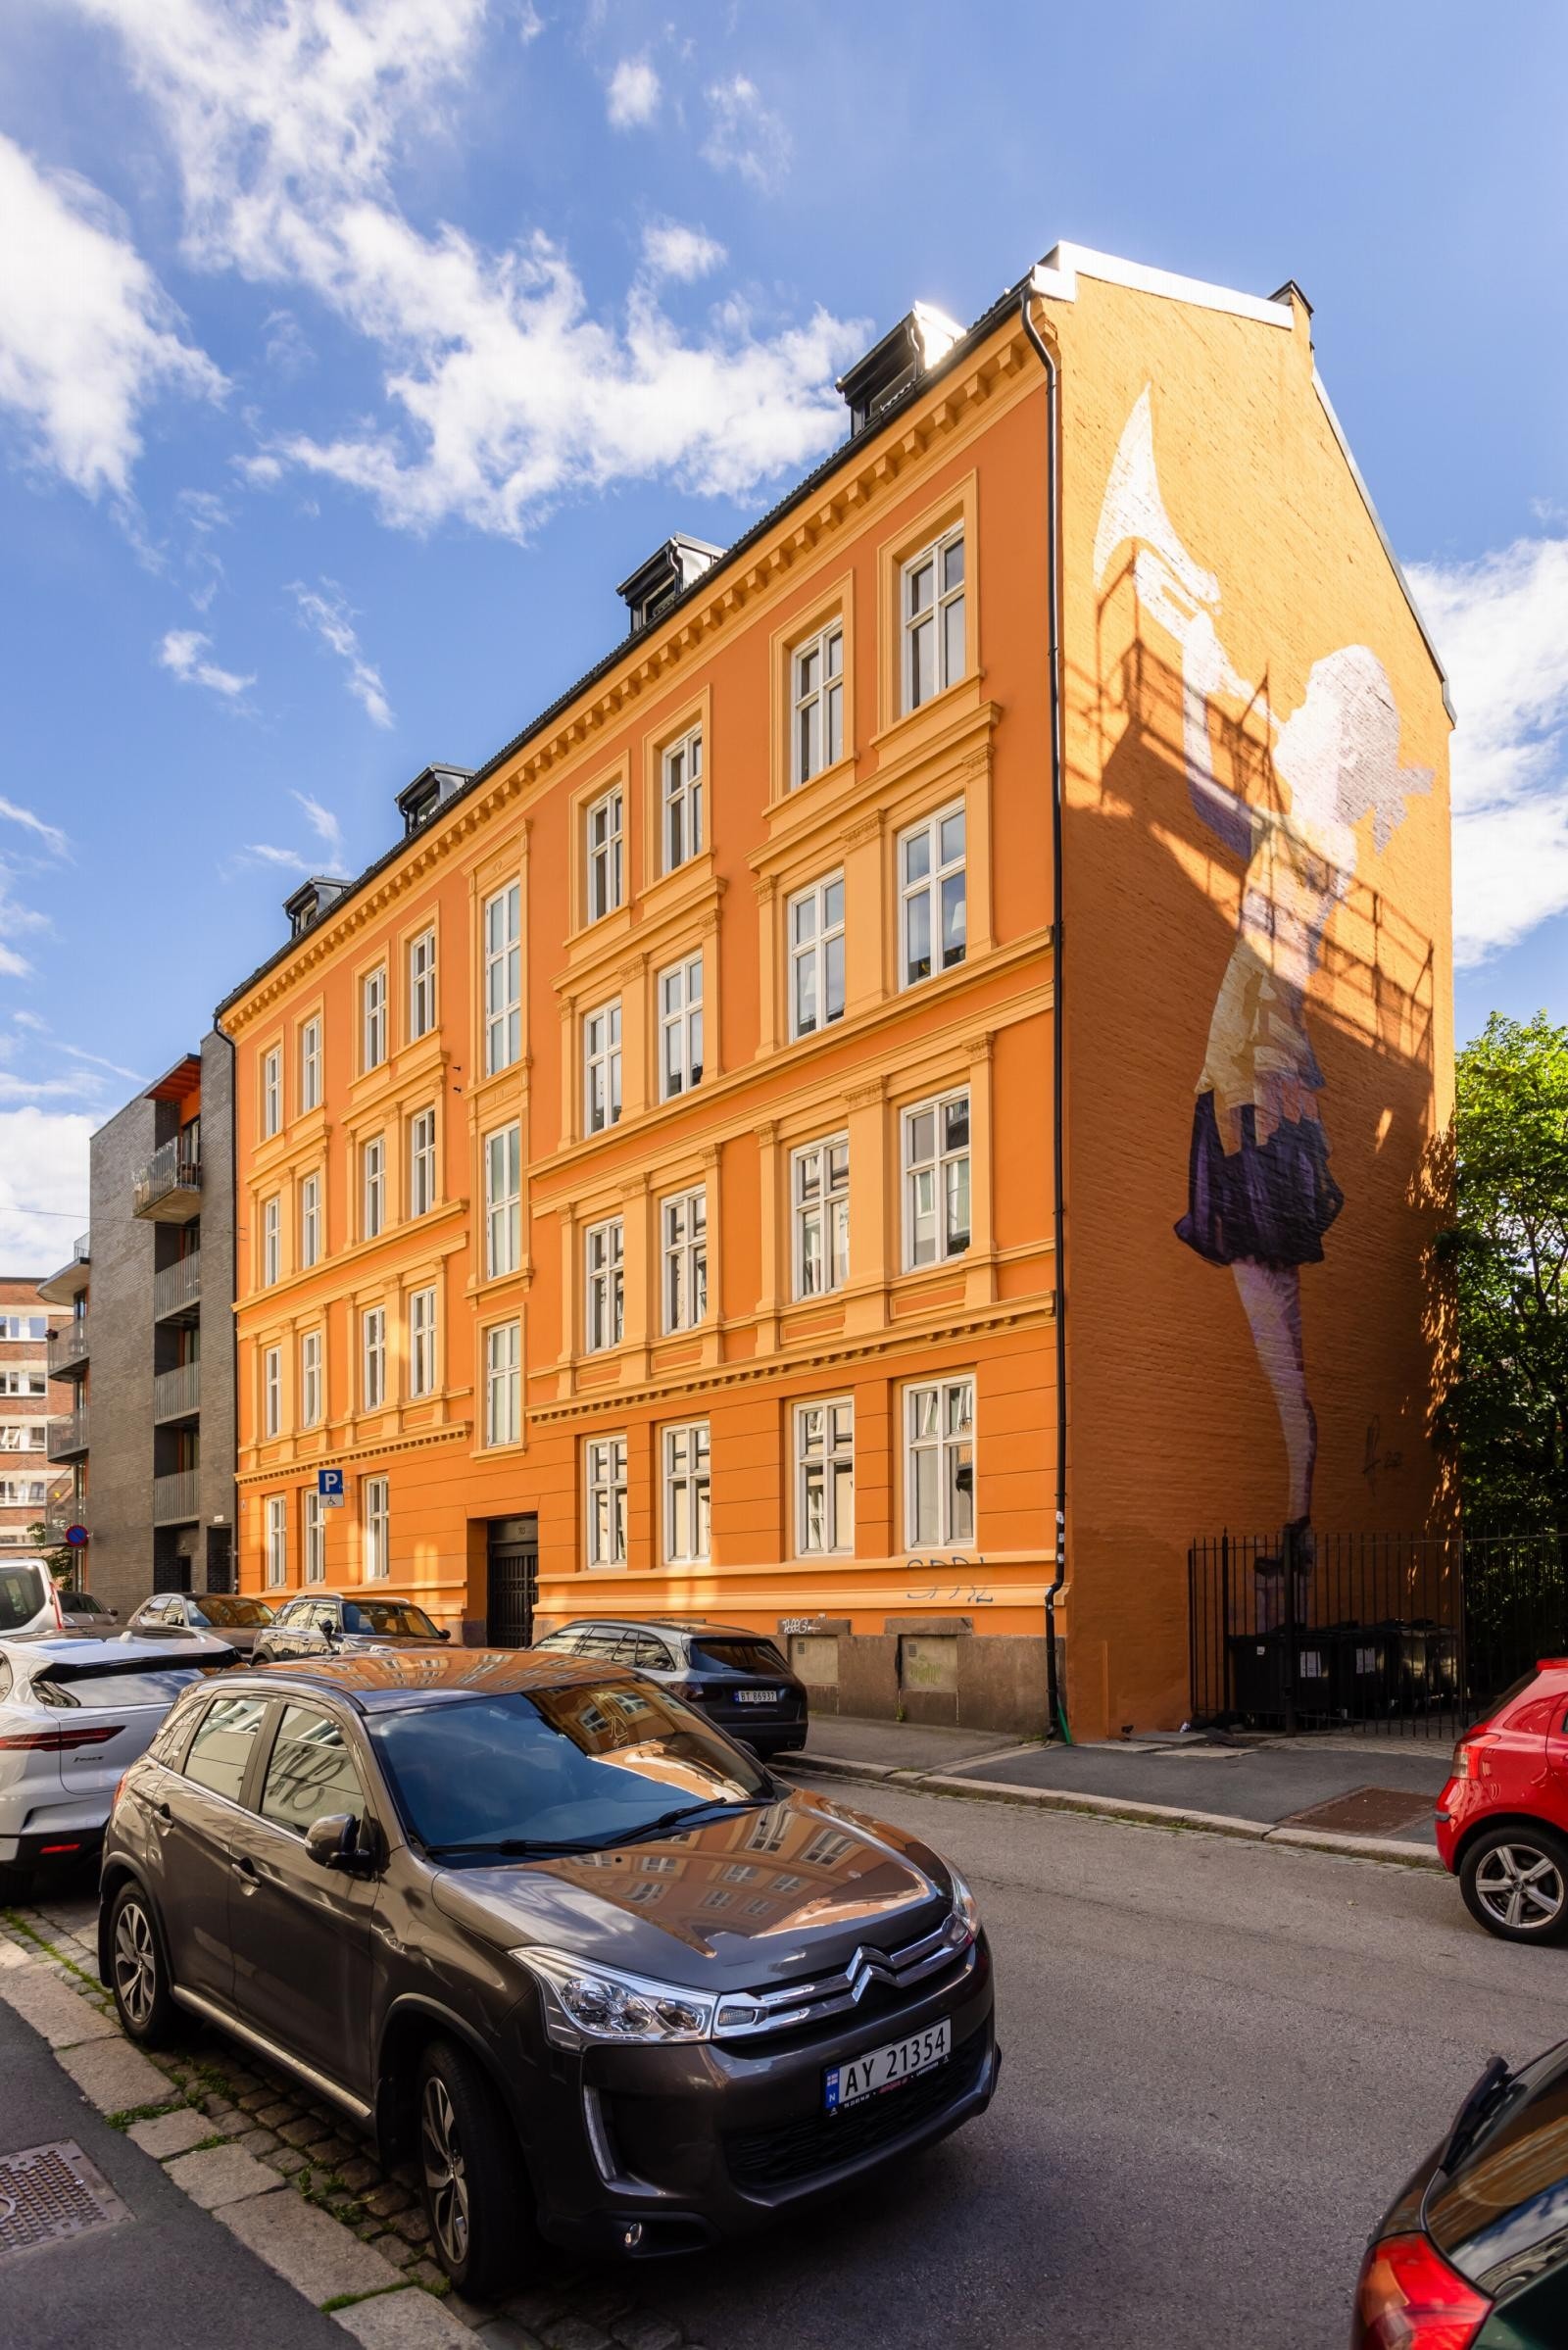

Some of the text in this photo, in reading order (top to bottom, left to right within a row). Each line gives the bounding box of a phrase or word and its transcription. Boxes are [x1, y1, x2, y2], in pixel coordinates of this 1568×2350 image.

[324, 1473, 338, 1492] P
[753, 1691, 775, 1701] 86937
[845, 2027, 946, 2096] AY 21354
[829, 2092, 836, 2103] N
